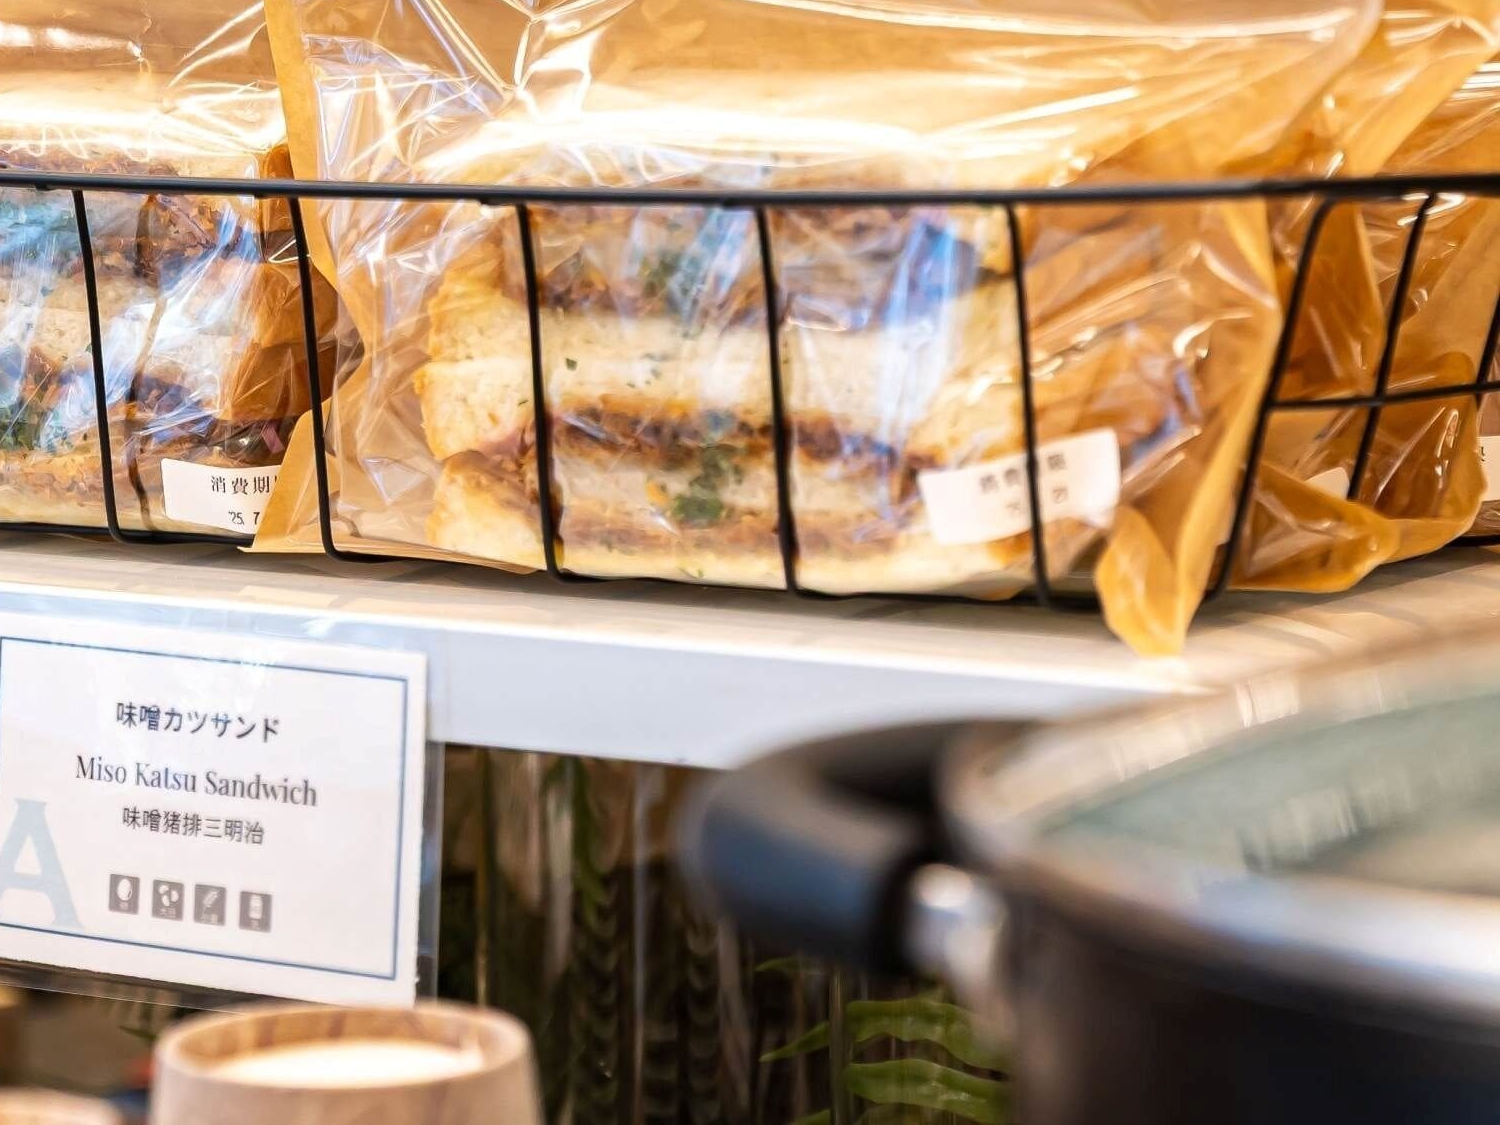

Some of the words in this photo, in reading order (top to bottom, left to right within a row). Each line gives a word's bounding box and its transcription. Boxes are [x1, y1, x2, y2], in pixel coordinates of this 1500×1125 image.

[211, 475, 278, 496] 消費期
[116, 702, 280, 743] 味噌カツサンド
[75, 754, 127, 785] Miso
[134, 761, 198, 793] Katsu
[204, 770, 318, 807] Sandwich
